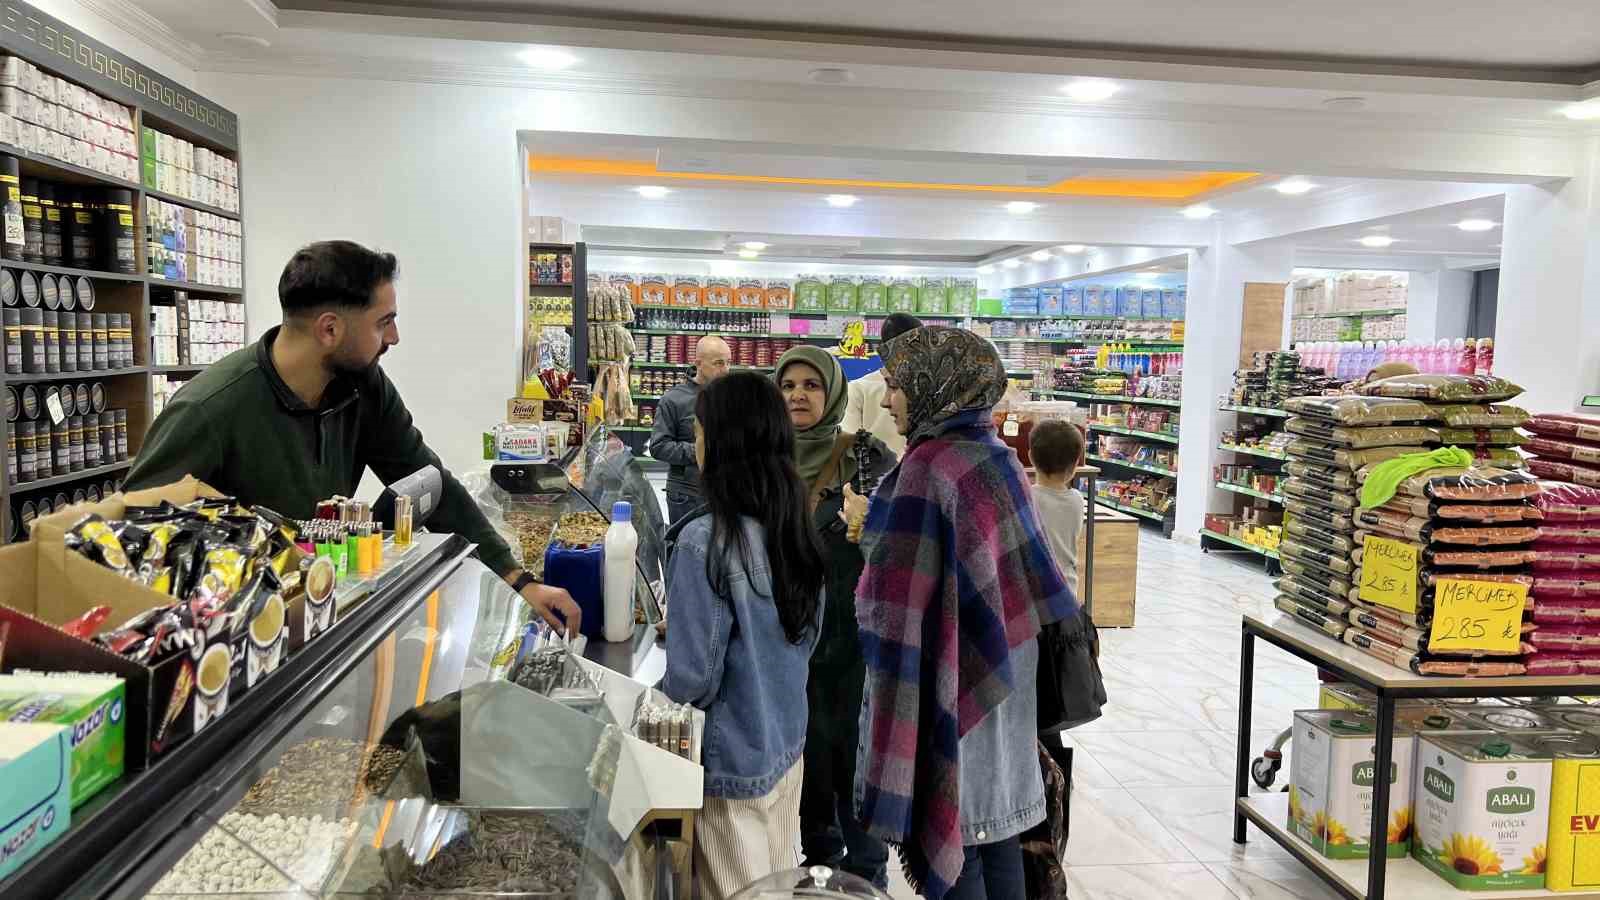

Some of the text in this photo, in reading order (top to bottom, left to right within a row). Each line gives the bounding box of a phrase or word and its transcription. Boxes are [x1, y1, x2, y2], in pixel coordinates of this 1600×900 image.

[1436, 617, 1489, 642] 285
[1426, 773, 1452, 796] ABALI
[1491, 794, 1530, 807] ABALI
